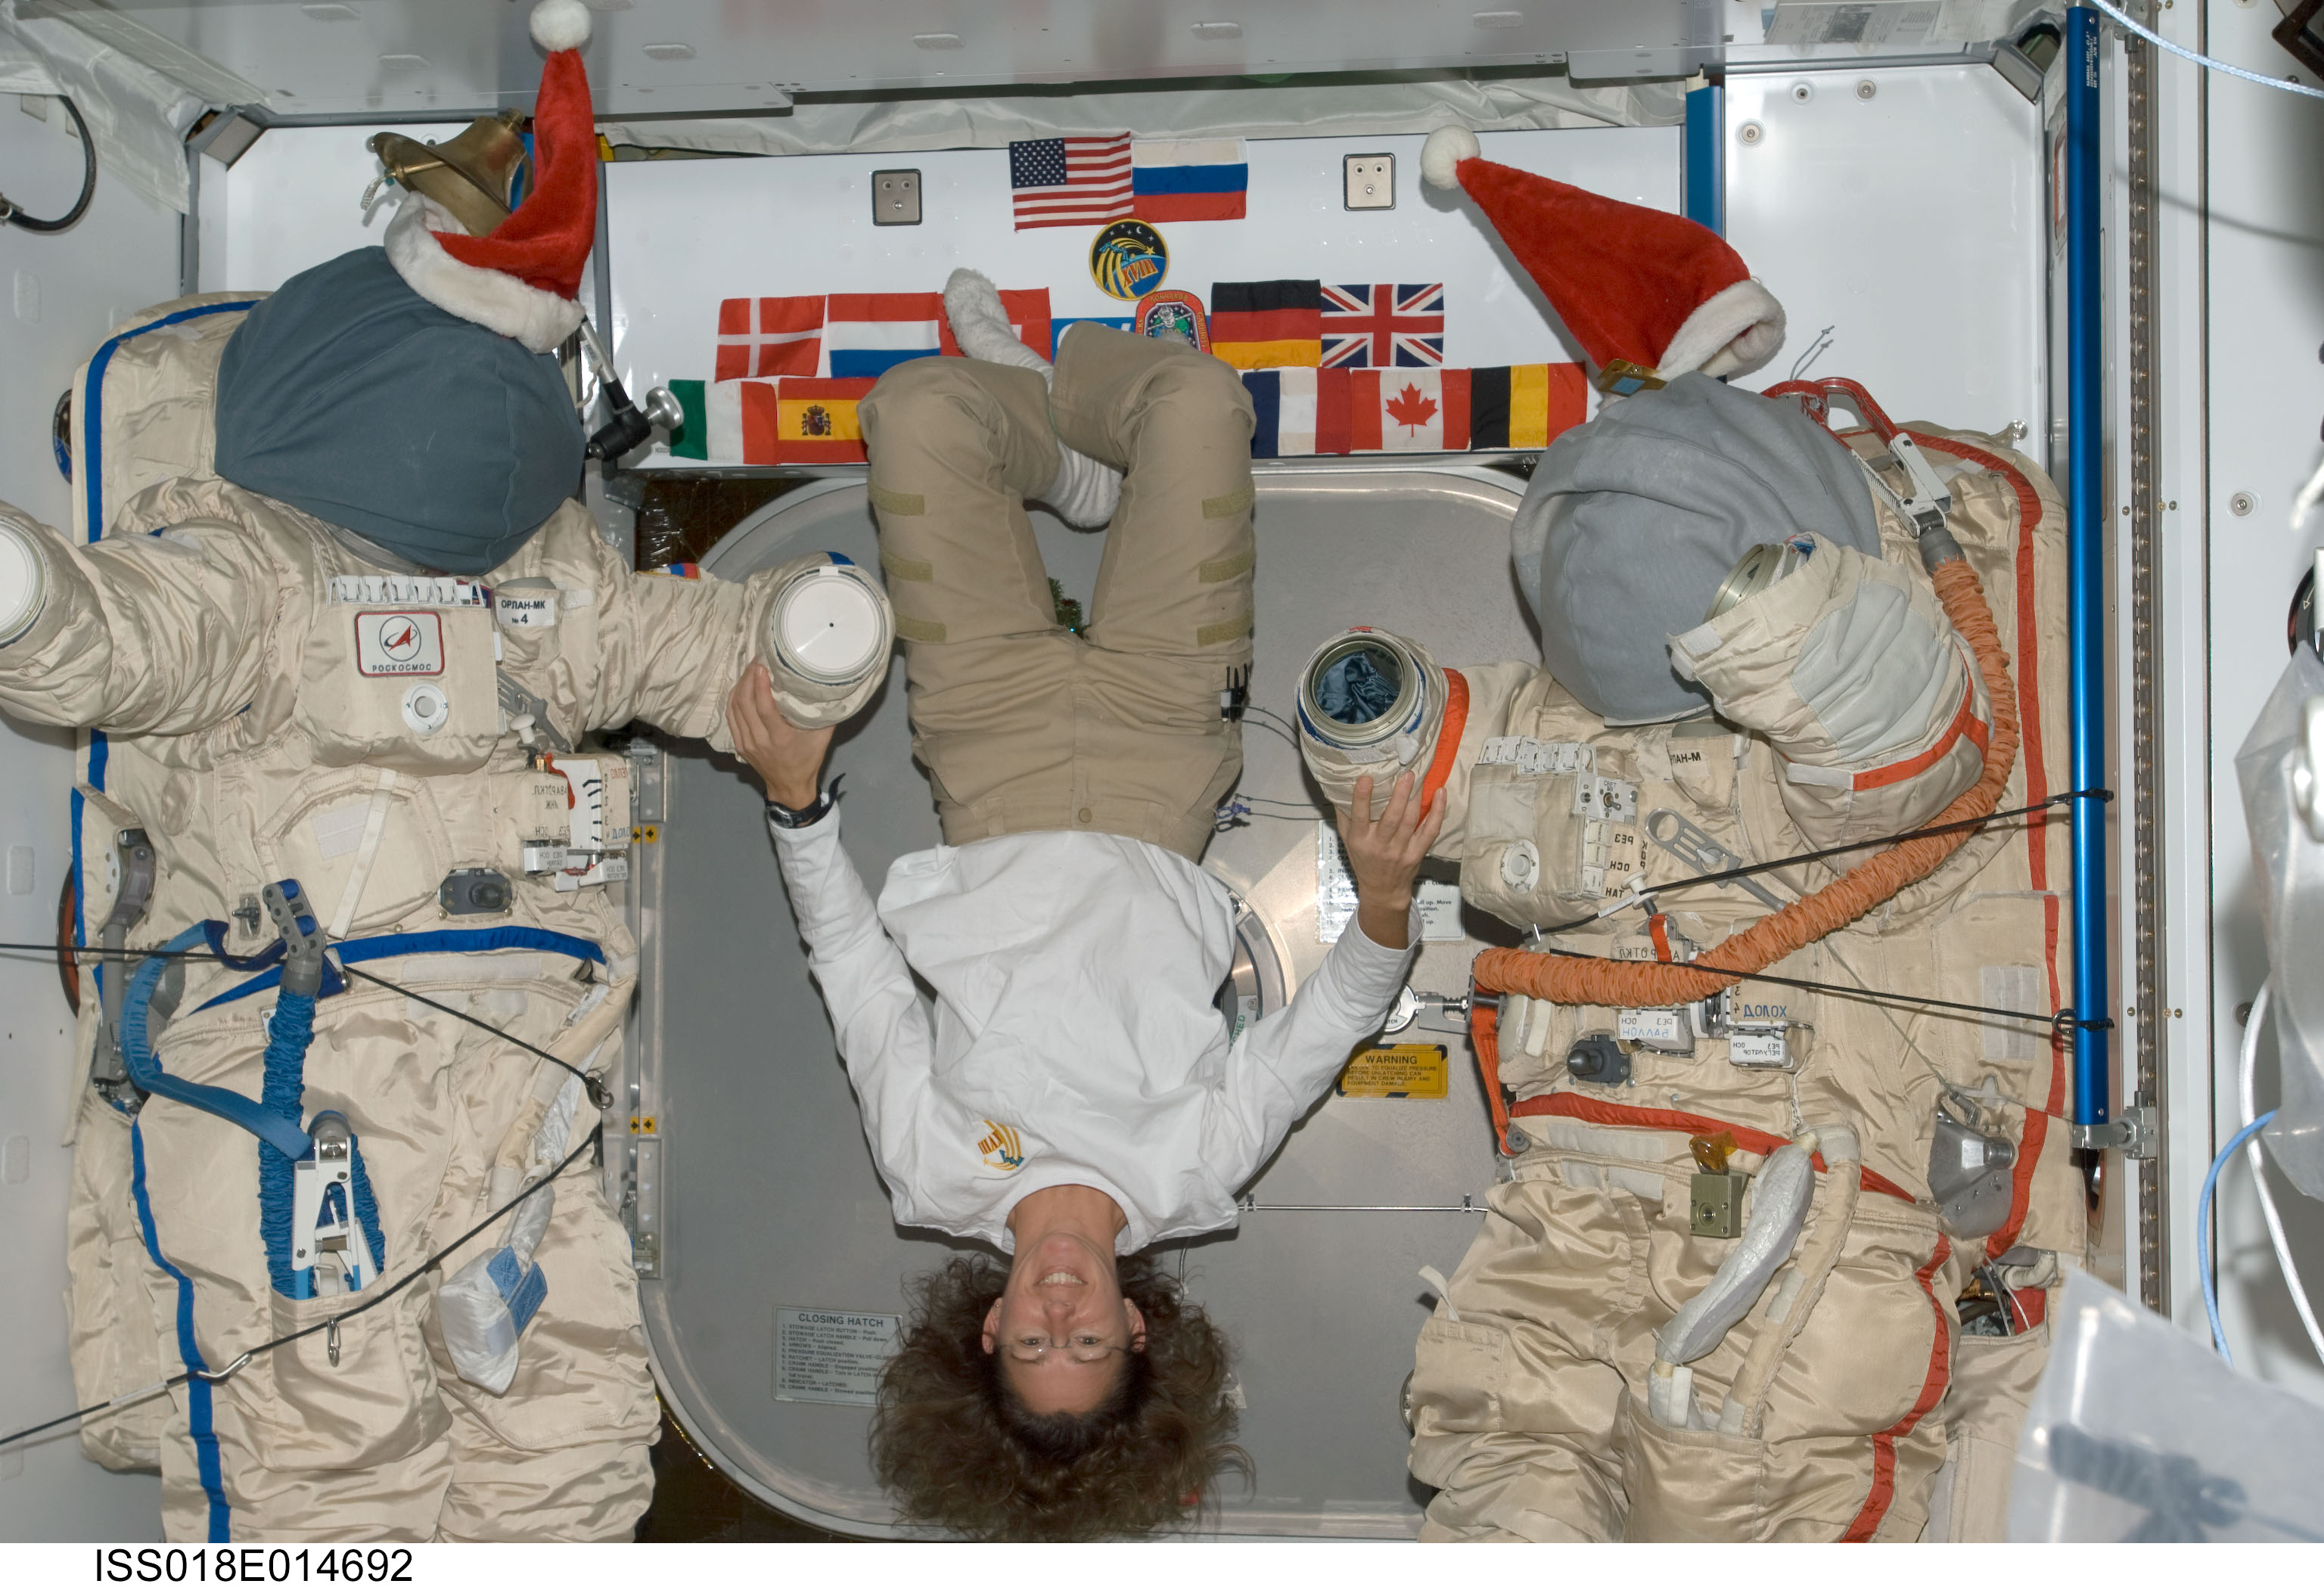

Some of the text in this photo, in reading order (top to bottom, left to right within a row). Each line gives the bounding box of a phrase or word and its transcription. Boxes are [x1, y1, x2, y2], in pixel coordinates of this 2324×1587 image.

[1123, 259, 1157, 287] XVIII
[501, 599, 546, 611] ОРЛАН-МК
[520, 613, 529, 624] 4
[372, 663, 431, 672] РОСКОСМОС
[1366, 1055, 1418, 1064] WARNING
[799, 1313, 884, 1328] CLOSING HATCH
